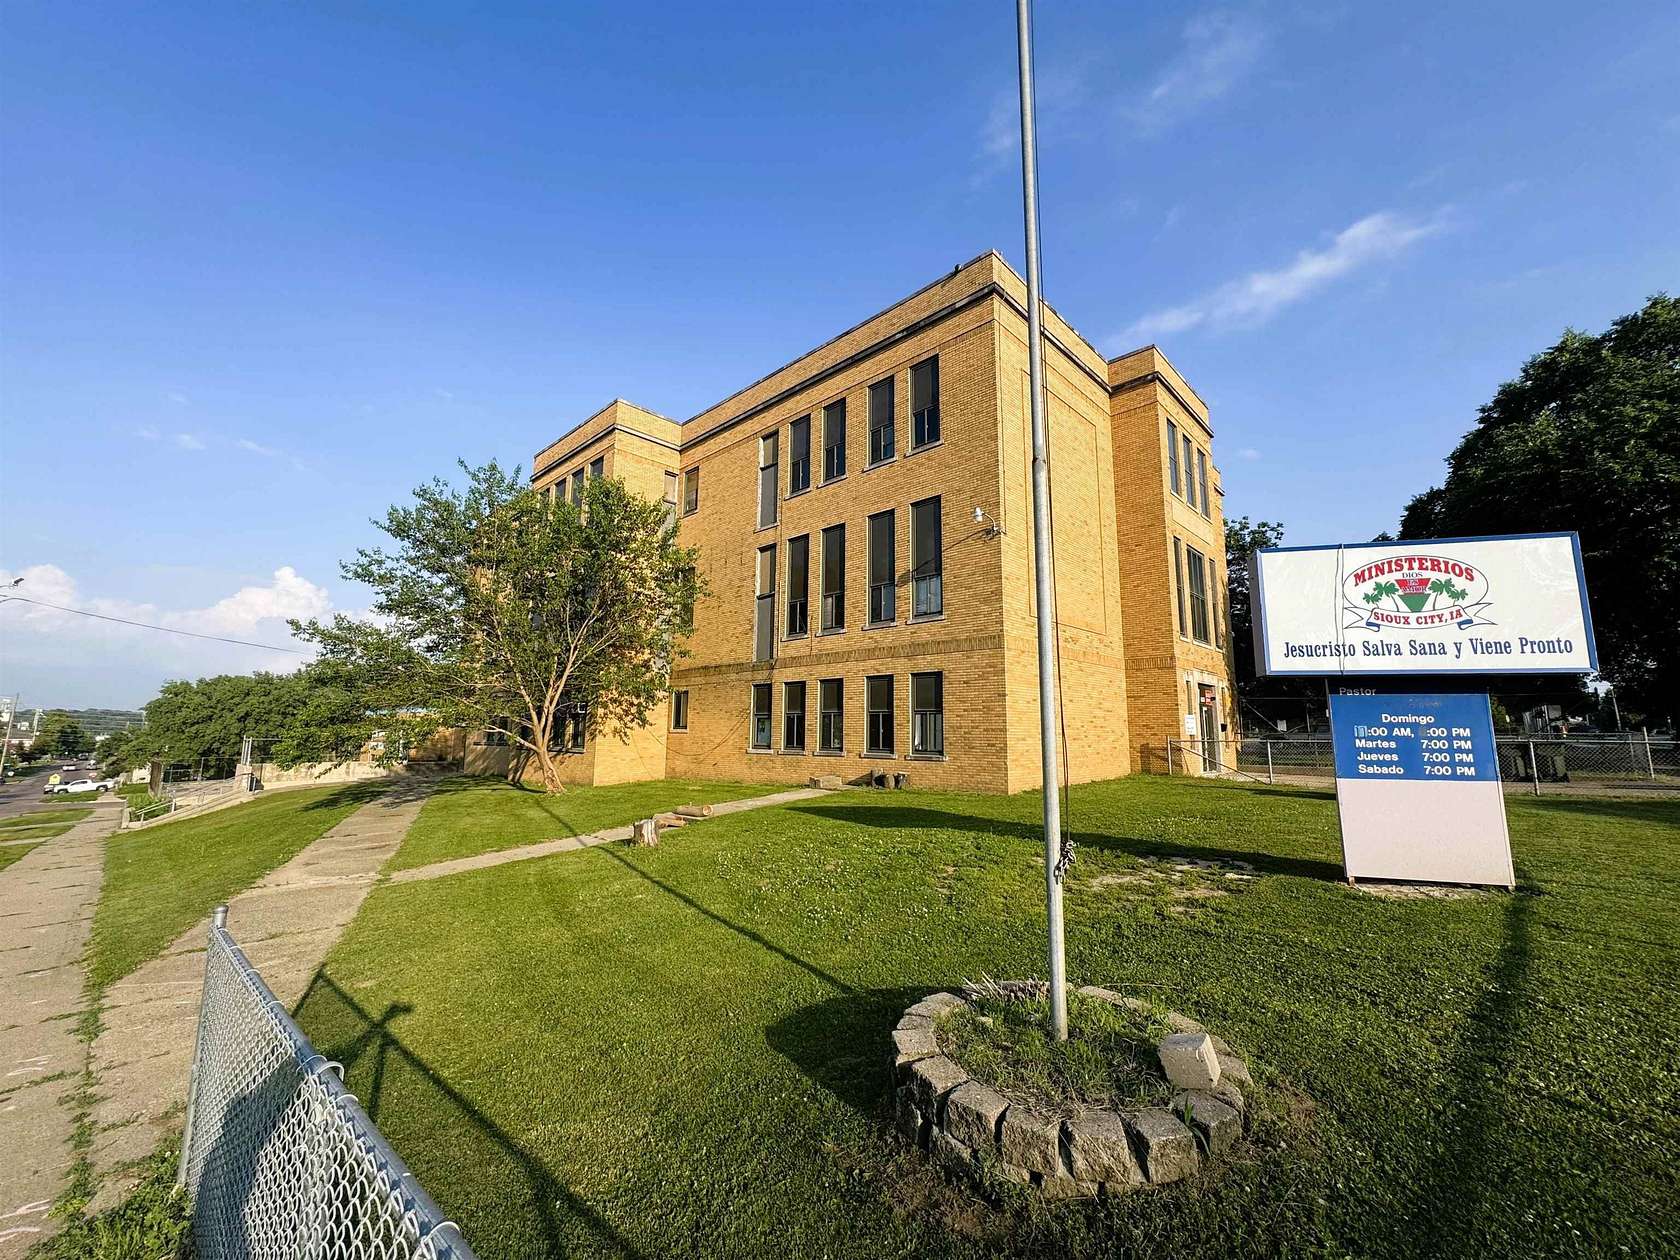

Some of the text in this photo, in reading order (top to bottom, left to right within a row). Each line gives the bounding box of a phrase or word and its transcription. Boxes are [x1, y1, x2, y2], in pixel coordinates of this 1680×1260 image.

[1353, 557, 1475, 587] MINISTERIOS
[1401, 571, 1424, 579] DIOS
[1373, 608, 1464, 625] SIOUX CITY, IA
[1283, 636, 1574, 659] Jesucristo Salva Sana y Viene Pronto
[1339, 687, 1377, 696] Pastor
[1381, 713, 1435, 725] Domingo
[1392, 727, 1415, 738] AM,
[1451, 728, 1471, 737] PM
[1355, 739, 1473, 750] Martes 7:00 PM
[1356, 751, 1474, 763] Jueves 7:00 PM
[1358, 764, 1476, 776] Sabado 7:00 PM
